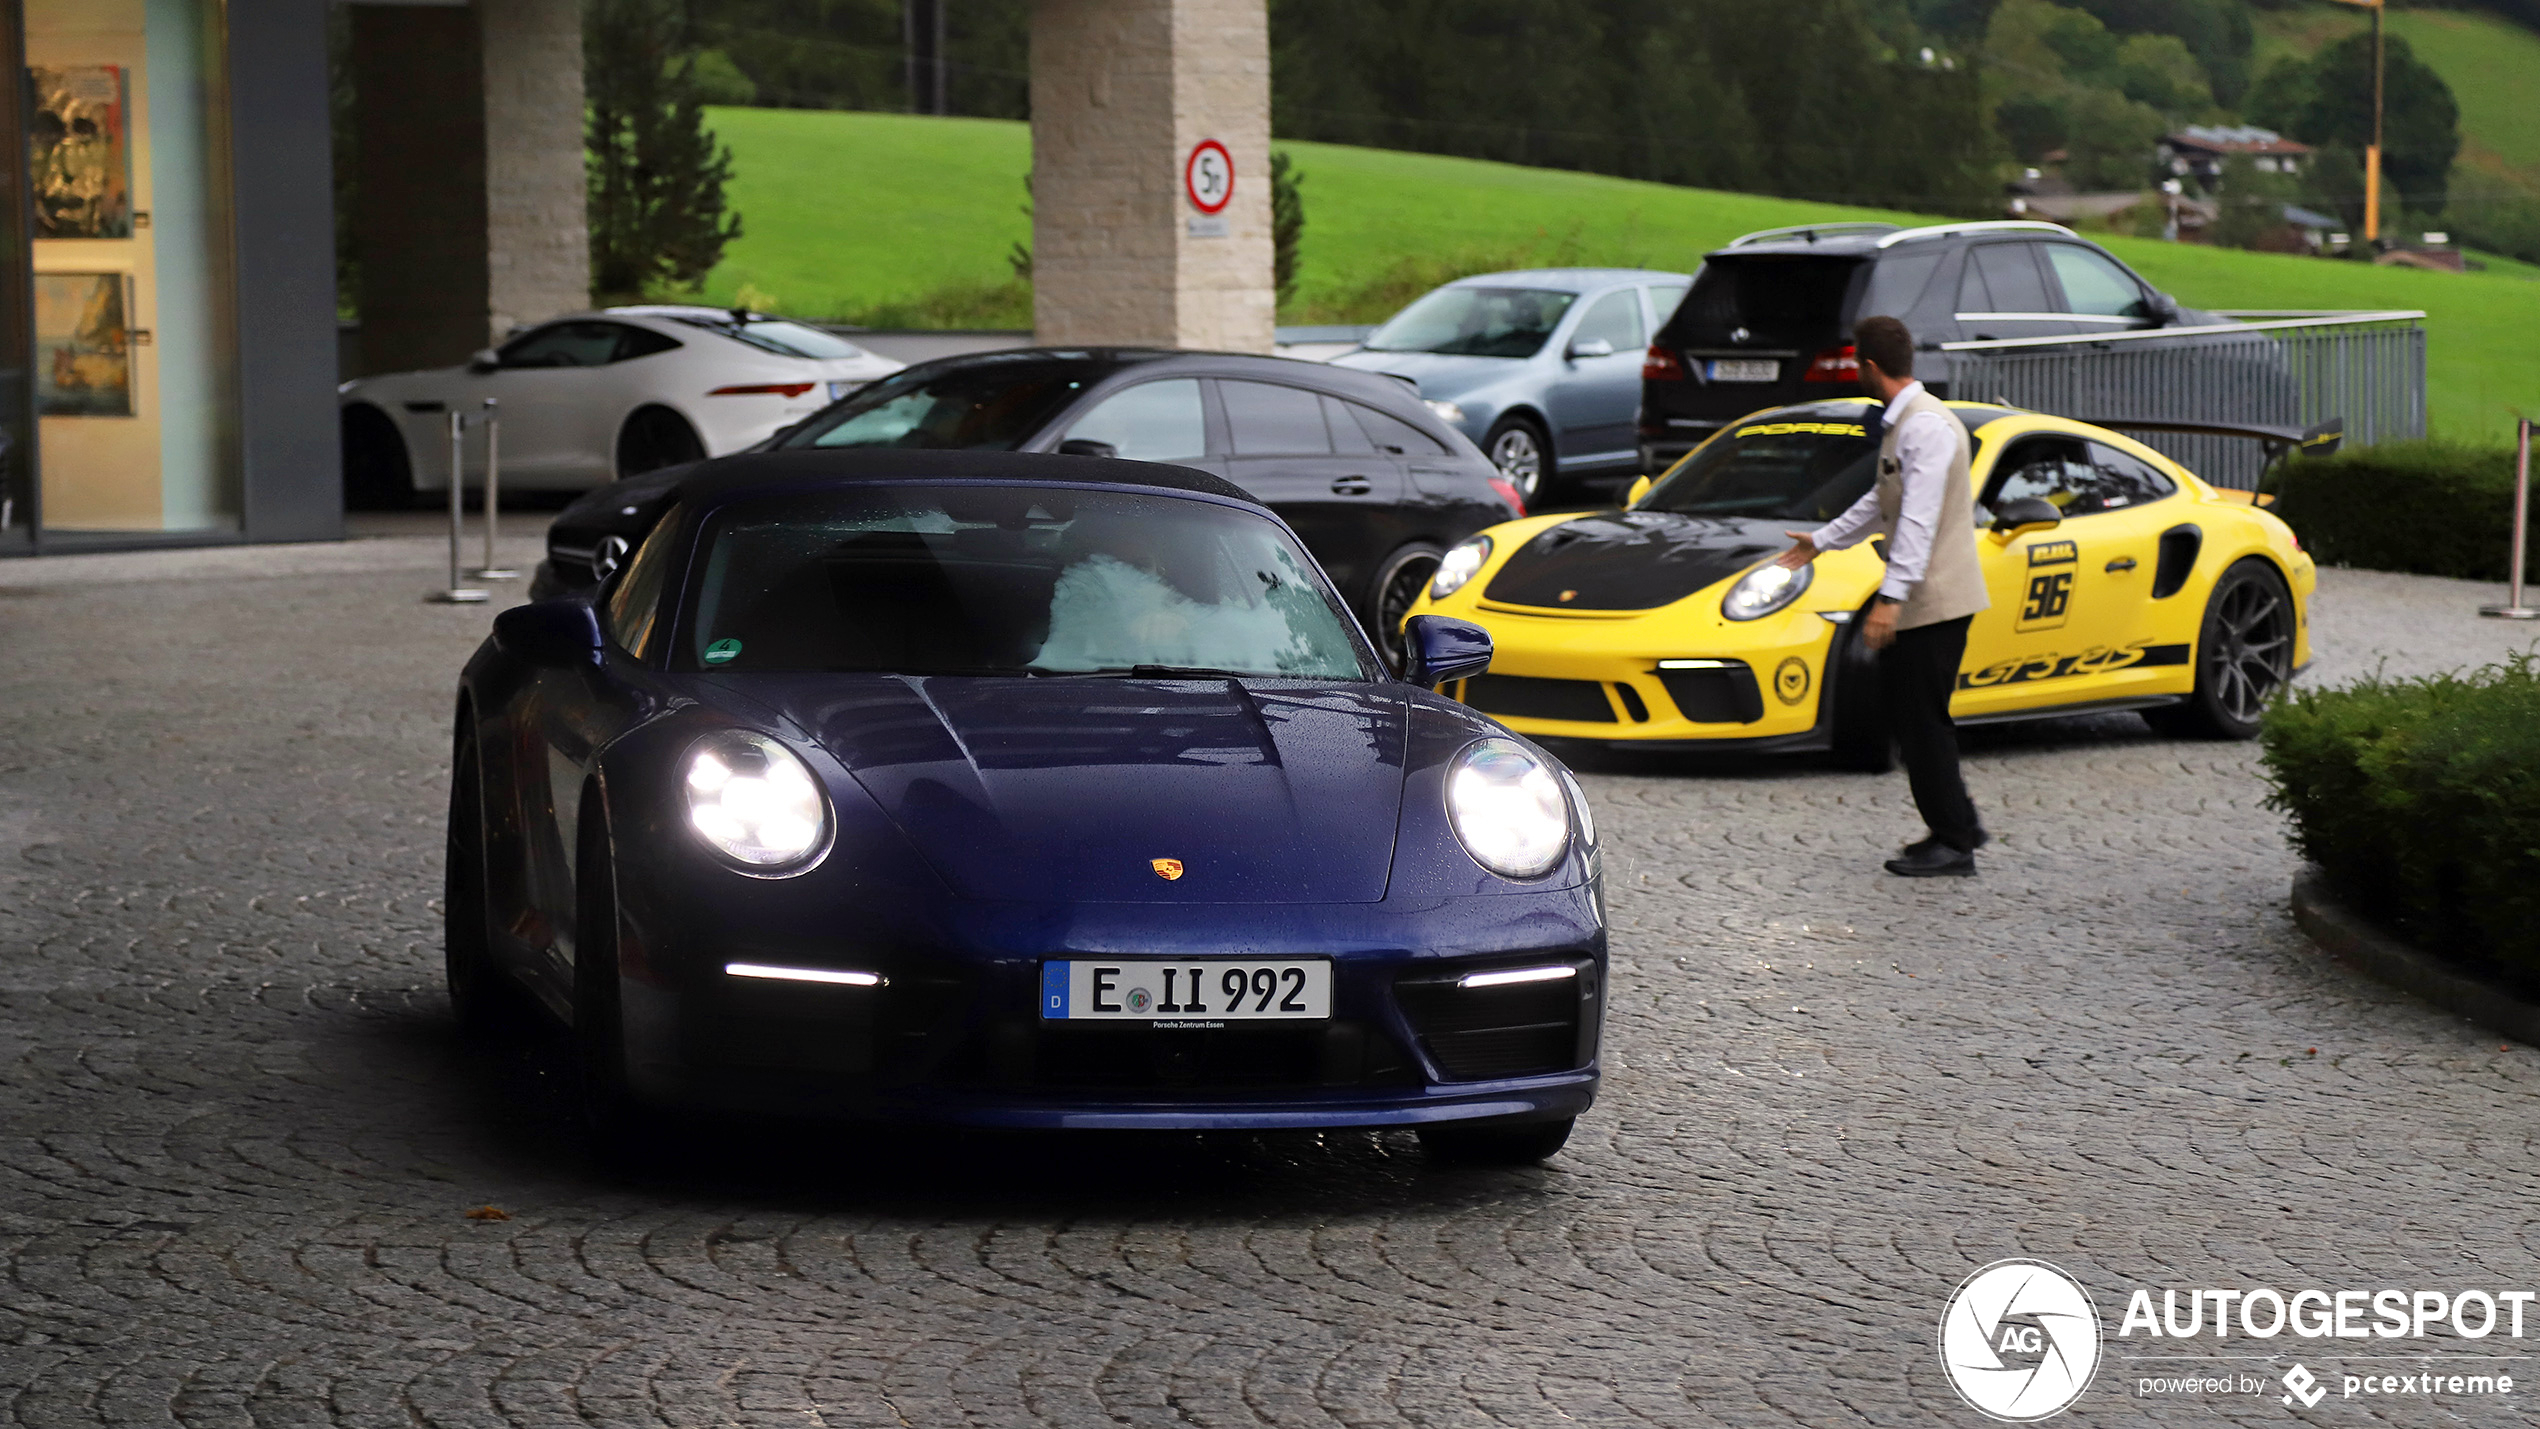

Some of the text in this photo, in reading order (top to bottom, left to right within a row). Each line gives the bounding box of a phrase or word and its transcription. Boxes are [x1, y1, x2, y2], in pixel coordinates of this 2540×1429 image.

[2023, 572, 2072, 620] 96
[719, 639, 731, 651] 4
[1093, 967, 1307, 1012] E II 992
[1051, 995, 1061, 1009] D
[1153, 1021, 1225, 1029] Porsche Zentrum Essen
